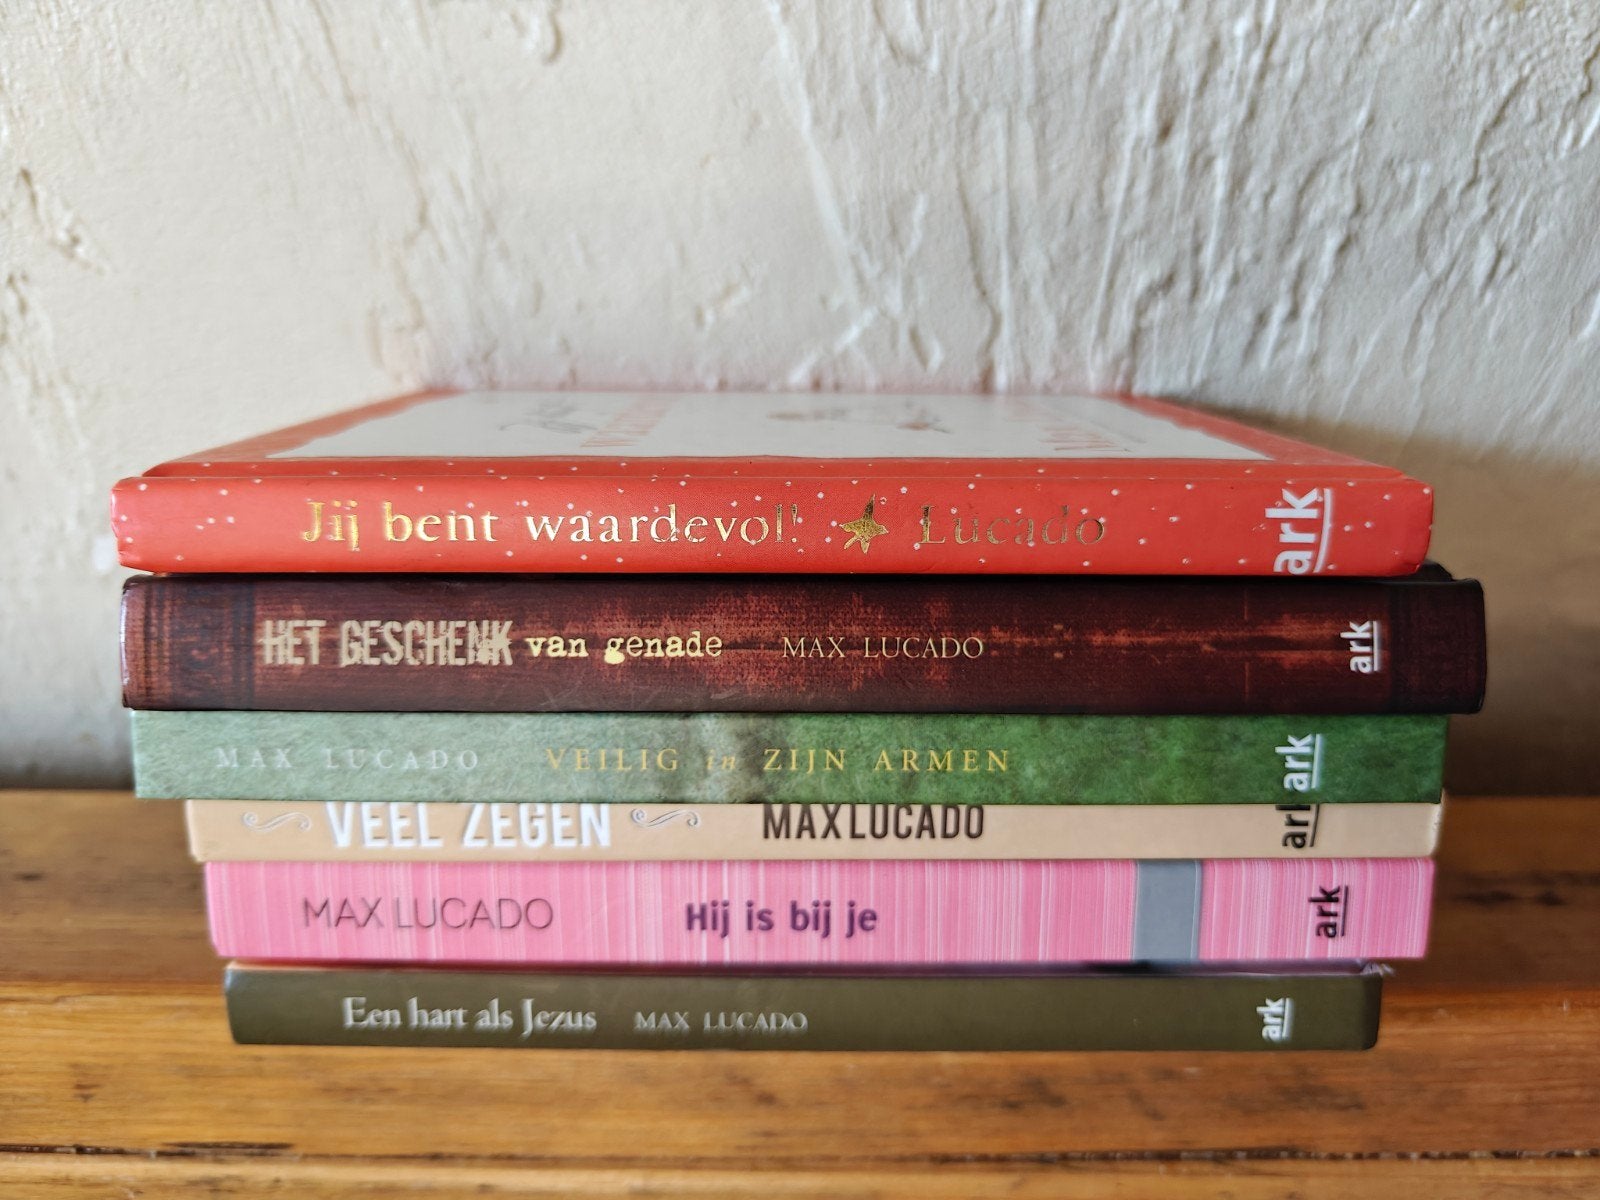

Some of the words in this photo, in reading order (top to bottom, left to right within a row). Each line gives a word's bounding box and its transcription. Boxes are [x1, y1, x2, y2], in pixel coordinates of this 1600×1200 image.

[303, 499, 361, 552] Jij
[382, 499, 499, 542] bent
[525, 503, 798, 543] waardevol!
[917, 503, 1105, 545] Lucado
[1264, 487, 1320, 575] ark
[258, 619, 327, 666] HET
[339, 619, 514, 668] GESCHENK
[524, 635, 589, 658] van
[603, 630, 723, 665] genade
[781, 636, 846, 659] MAX
[863, 636, 984, 659] LUCADO
[1340, 620, 1373, 674] ark
[216, 748, 292, 769] MAX
[325, 748, 478, 770] LUCADO
[546, 748, 680, 771] VEILIG
[705, 750, 737, 771] in
[763, 748, 845, 775] ZIJN
[874, 749, 1010, 772] ARMEN
[1274, 733, 1313, 793] ark
[325, 802, 444, 849] VEEL
[461, 803, 612, 848] ZEGEN
[303, 897, 384, 928] MAX
[396, 897, 555, 929] LUCADO
[686, 900, 730, 938] Hij
[745, 900, 774, 931] is
[790, 900, 832, 938] bij
[845, 900, 878, 938] je
[1308, 886, 1341, 938] ark
[341, 996, 402, 1029] Een
[406, 997, 468, 1029] hart
[474, 997, 514, 1030] als
[520, 998, 598, 1038] Jezus
[633, 1011, 690, 1033] MAX
[703, 1011, 808, 1034] LUCADO
[1256, 998, 1285, 1041] ark
